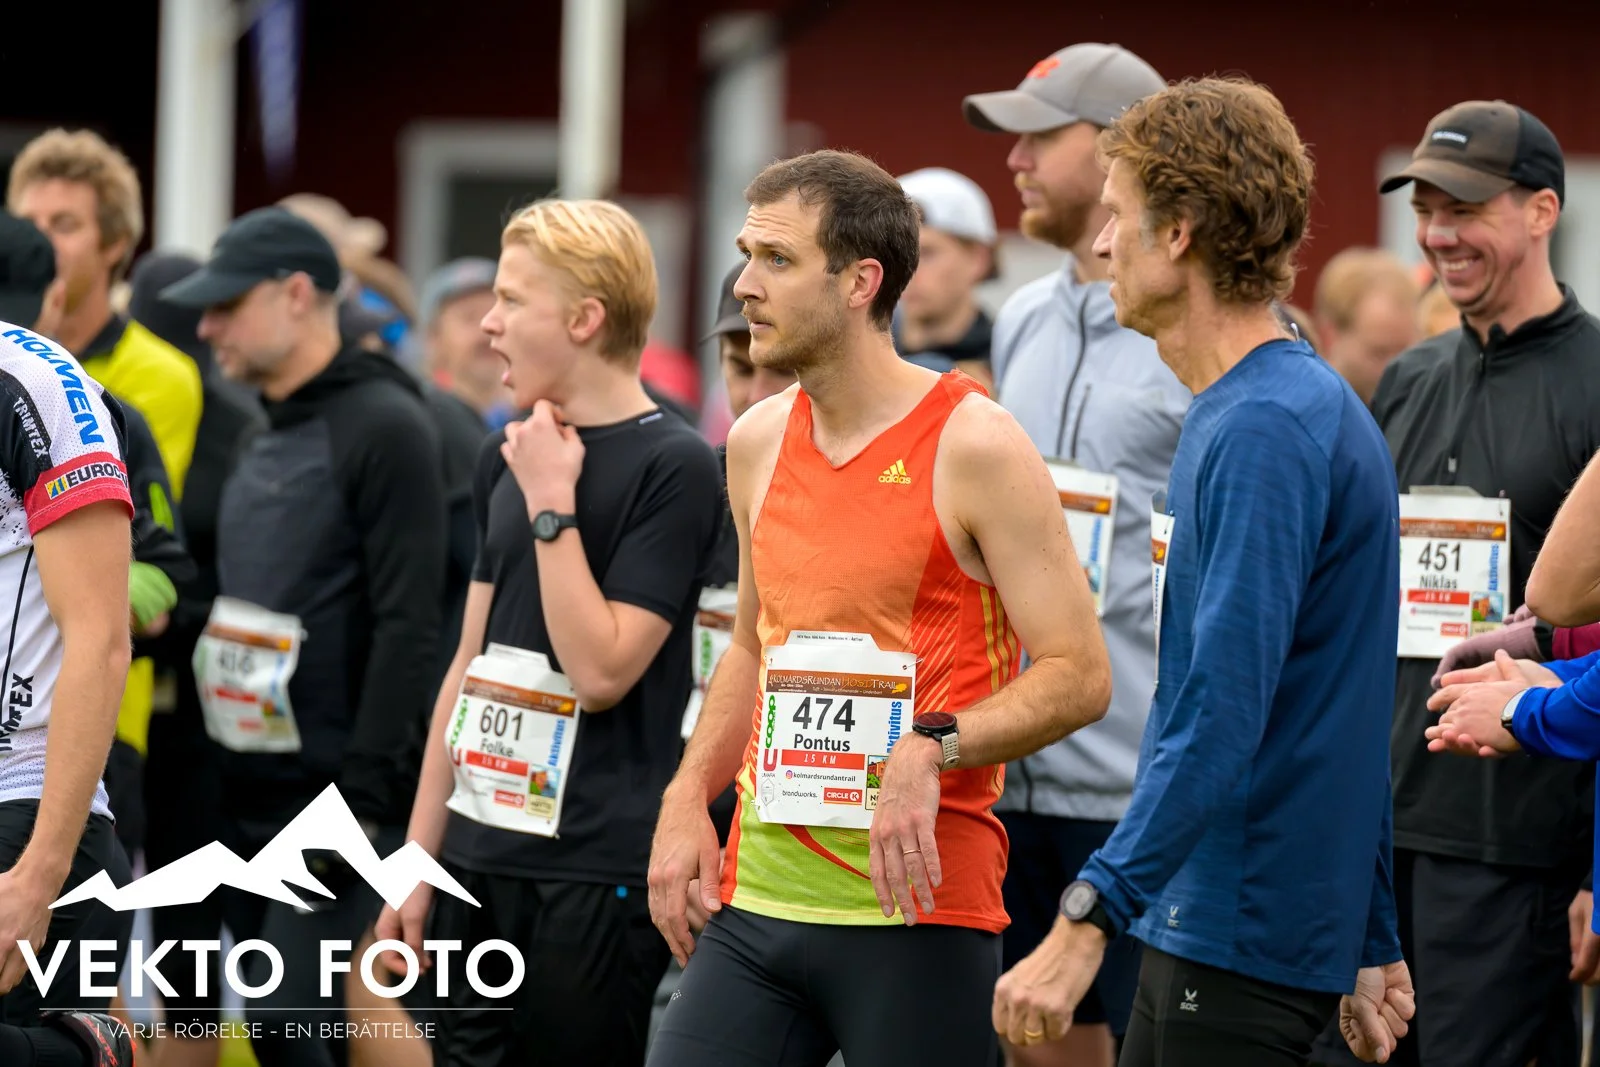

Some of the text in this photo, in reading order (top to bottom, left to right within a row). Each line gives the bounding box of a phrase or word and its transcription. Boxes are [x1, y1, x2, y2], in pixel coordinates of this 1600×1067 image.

[2, 329, 105, 445] HOLMEN
[13, 397, 48, 458] TRIMTEX
[878, 474, 912, 485] adidas
[1418, 541, 1461, 572] 451
[1420, 576, 1457, 590] Niklas
[480, 705, 524, 741] 601
[792, 696, 855, 732] 474
[480, 738, 515, 757] Folke
[794, 733, 851, 752] Pontus
[804, 753, 837, 765] 15 KM
[793, 772, 856, 782] kolmardsrundantrail
[826, 791, 849, 799] CIRCLE
[1180, 1002, 1199, 1012] SOC
